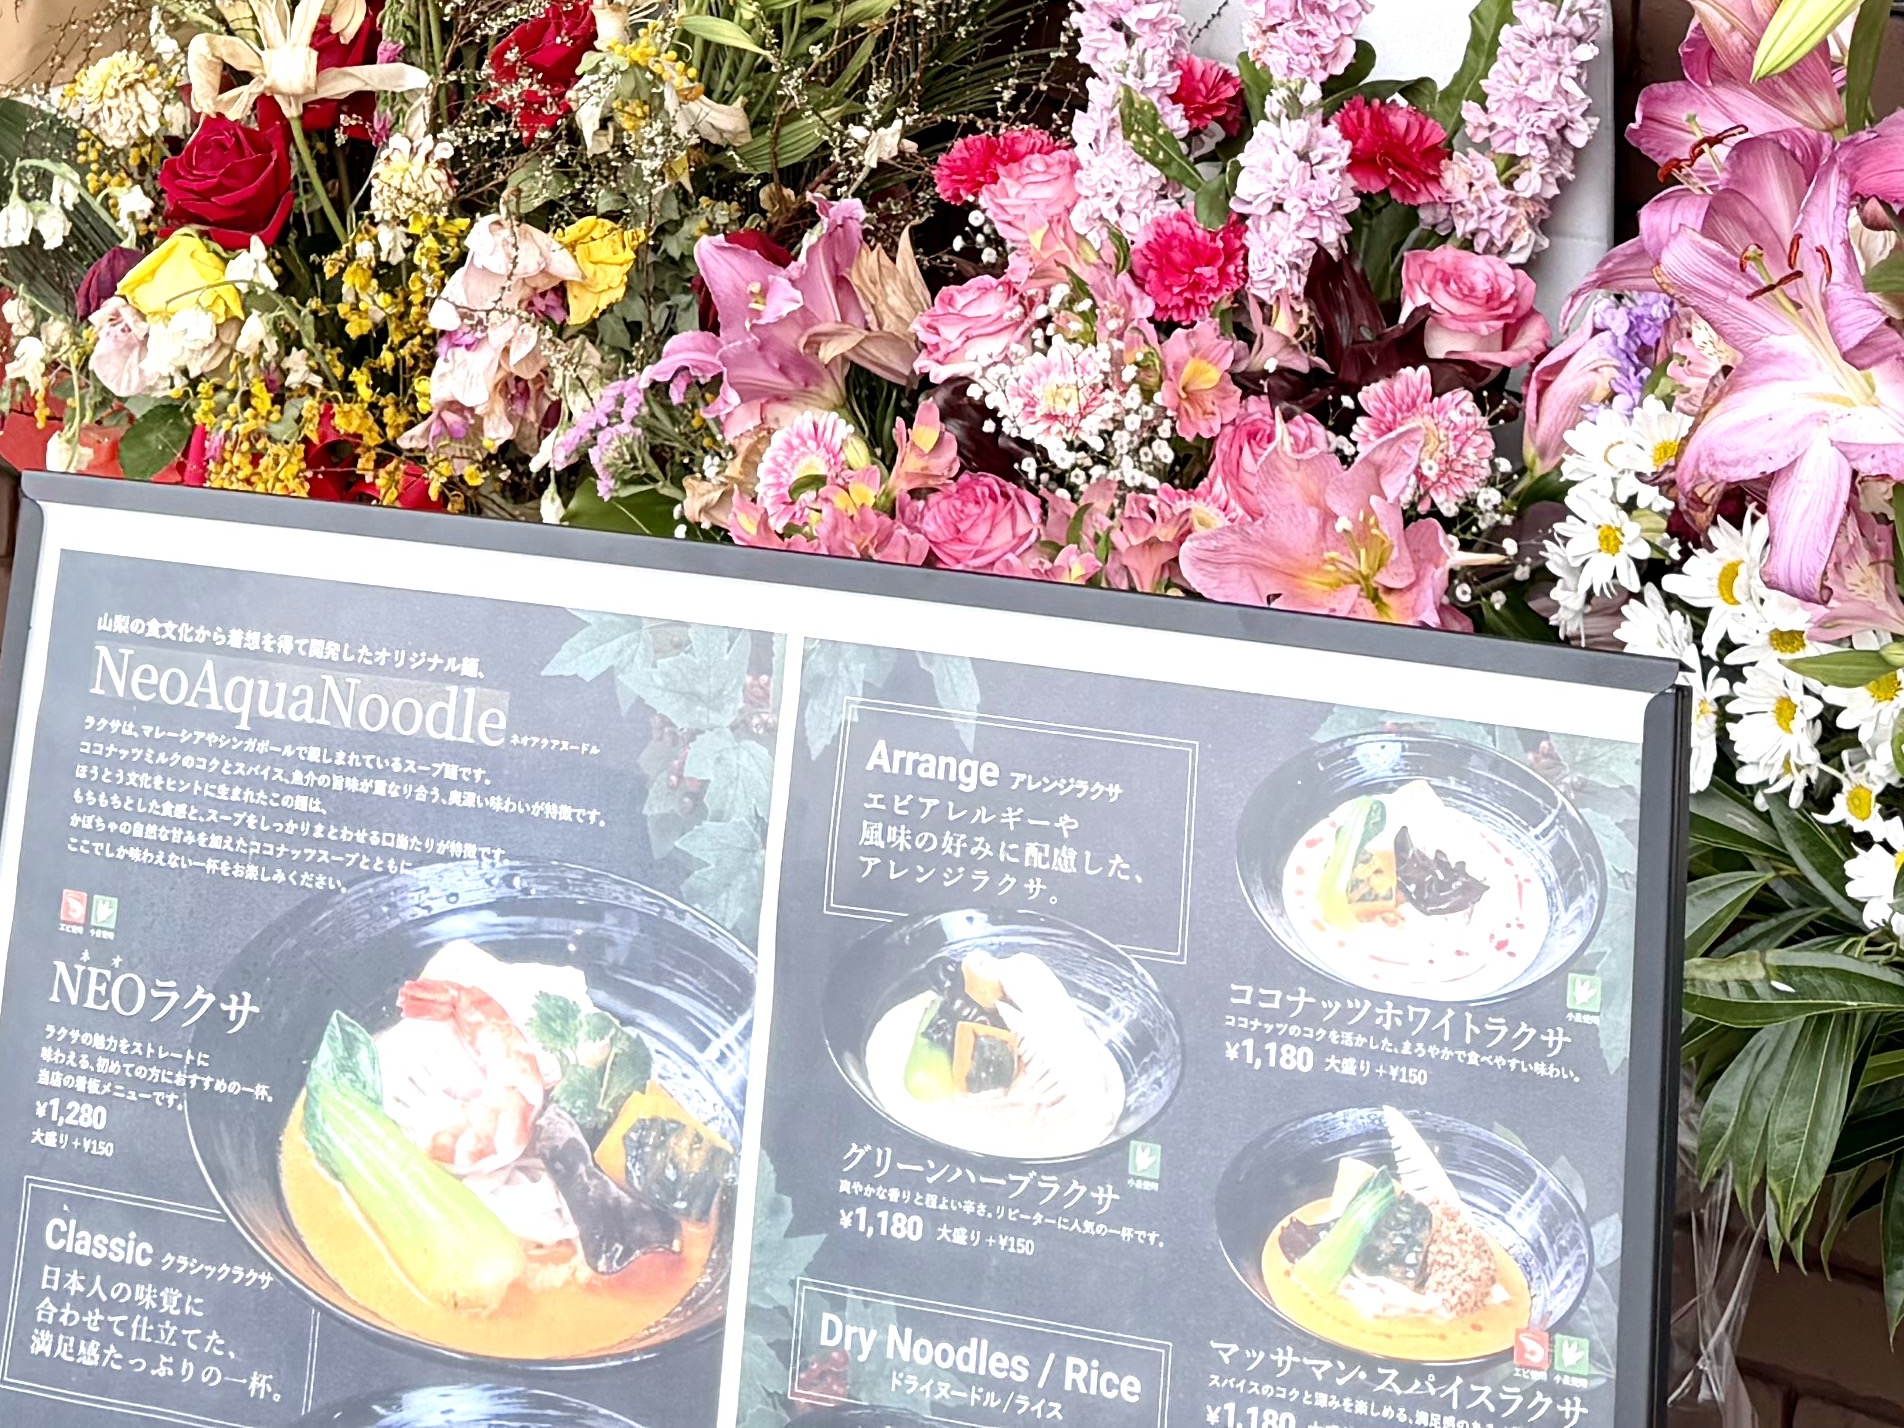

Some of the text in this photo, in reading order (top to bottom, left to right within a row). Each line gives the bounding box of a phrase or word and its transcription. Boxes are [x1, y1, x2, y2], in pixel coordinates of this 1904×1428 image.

[89, 644, 507, 747] NeoAquaNoodle
[865, 739, 1124, 803] Arrange アレンジラクサ
[863, 793, 1079, 838] エビアレルギーや
[859, 855, 1058, 905] アレンジラクサ。
[48, 960, 261, 1034] NEOラクサ
[1229, 982, 1572, 1058] ココナッツホワイトラクサ
[1225, 1037, 1314, 1073] ¥1,180
[36, 1097, 107, 1130] ¥1,280
[842, 1142, 1121, 1215] グリーンハーブラクサ
[45, 1217, 275, 1291] Classic クラシックラクサ
[839, 1207, 924, 1242] ¥1,180
[41, 1265, 204, 1318] 日本人の味覚に
[35, 1297, 237, 1361] 合わせて仕立てた、
[820, 1312, 877, 1363] Dry
[886, 1324, 1030, 1384] Noodles
[1064, 1355, 1143, 1404] Rice
[30, 1328, 282, 1403] 満足感たっぷりの一杯。
